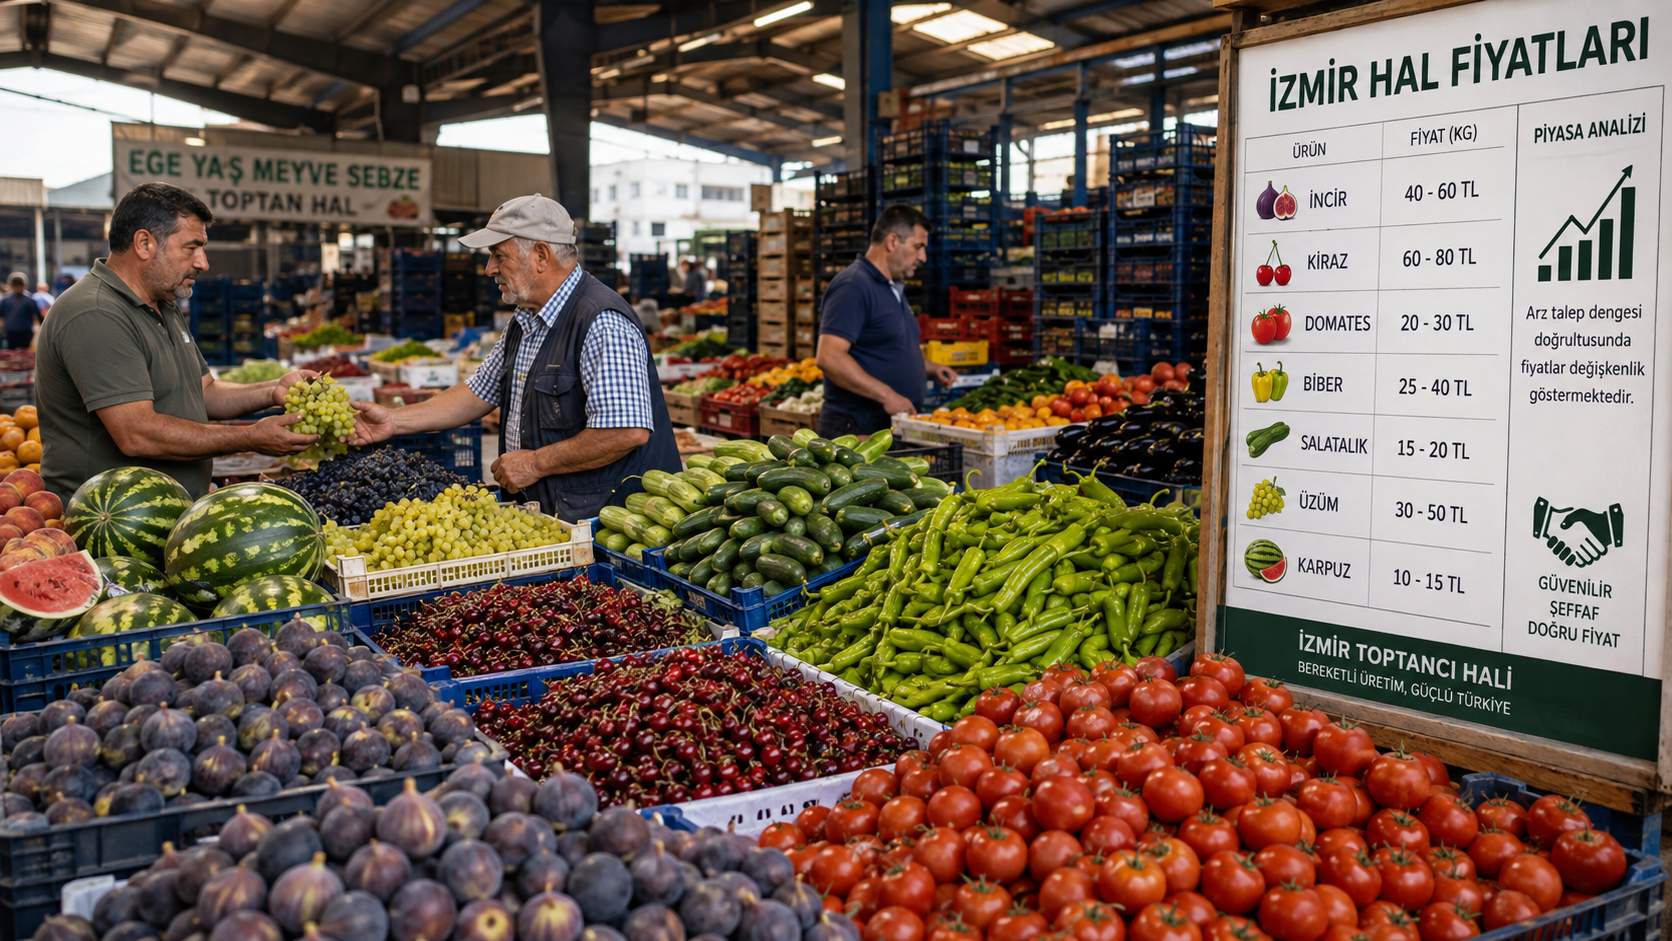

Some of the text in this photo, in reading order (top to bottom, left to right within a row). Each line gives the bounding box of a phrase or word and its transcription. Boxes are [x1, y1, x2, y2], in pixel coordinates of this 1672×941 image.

[1269, 15, 1650, 113] İZMİR HAL FİYATLARI
[1410, 123, 1478, 147] FİYAT (KG)
[1533, 111, 1647, 144] PİYASA ANALİZİ
[1292, 141, 1327, 159] ÜRÜN
[129, 150, 420, 190] EGE YAŞ MEYVE SEBZE
[1309, 187, 1348, 209] İNCİR
[1404, 184, 1424, 203] 40
[1437, 181, 1457, 201] 60
[1460, 179, 1480, 199] TL
[206, 188, 358, 218] TOPTAN HAL
[1307, 250, 1349, 271] KİRAZ
[1402, 249, 1422, 268] 60
[1435, 247, 1455, 267] 80
[1457, 247, 1477, 266] TL
[1304, 314, 1371, 332] DOMATES
[1400, 313, 1419, 332] 20
[1432, 313, 1452, 332] 30
[1455, 313, 1475, 332] TL
[1525, 303, 1643, 323] Arz talep dengesi
[1534, 331, 1632, 350] doğrultusunda
[1520, 358, 1646, 380] fiyatlar değişkenlik
[1303, 372, 1343, 393] BİBER
[1398, 377, 1417, 396] 25
[1430, 378, 1450, 397] 40
[1453, 379, 1473, 397] TL
[1529, 386, 1635, 405] göstermektedir.
[1300, 434, 1369, 455] SALATALIK
[1397, 439, 1415, 457] 15
[1428, 440, 1448, 459] 20
[1451, 441, 1470, 460] TL
[1299, 489, 1339, 513] ÜZÜM
[1394, 500, 1414, 519] 30
[1427, 503, 1446, 522] 50
[1449, 505, 1469, 525] TL
[1297, 556, 1352, 580] KARPUZ
[1393, 568, 1411, 587] 10
[1425, 572, 1444, 591] 15
[1447, 574, 1466, 595] TL
[1538, 573, 1613, 599] GÜVENİLİR
[1549, 600, 1600, 621] ŞEFFAF
[1527, 620, 1621, 649] DOĞRU FİYAT
[1298, 628, 1513, 691] İZMİR TOPTANCI HALİ
[1298, 660, 1357, 684] BEREKETLİ
[1360, 670, 1408, 696] ÜRETİM,
[1456, 690, 1511, 716] TÜRKİYE
